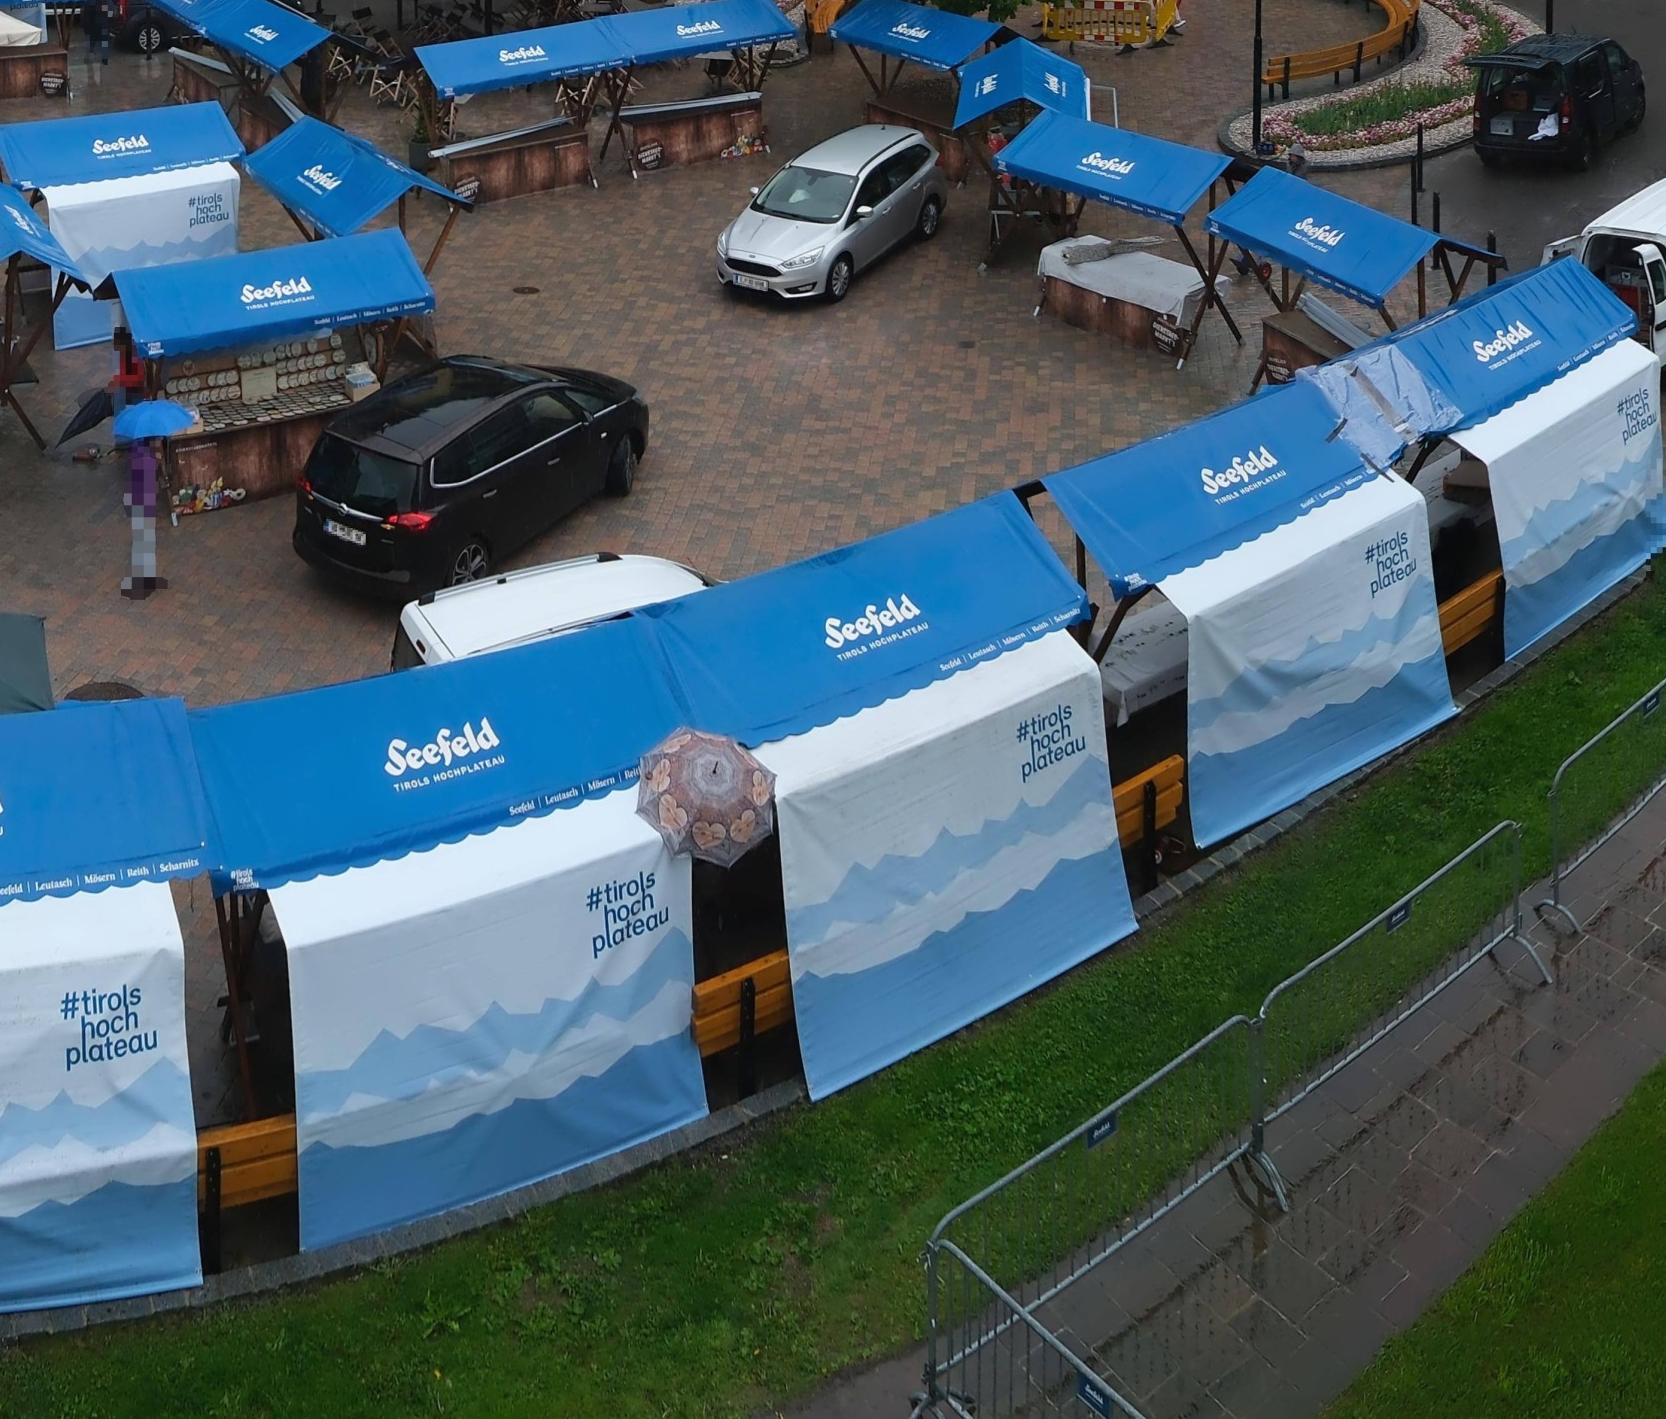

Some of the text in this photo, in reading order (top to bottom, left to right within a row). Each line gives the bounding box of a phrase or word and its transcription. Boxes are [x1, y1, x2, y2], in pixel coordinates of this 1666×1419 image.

[676, 20, 721, 37] Seefeld
[892, 23, 932, 40] Seefeld
[499, 45, 546, 63] Seefeld
[92, 134, 150, 155] Seefeld
[303, 164, 342, 191] Seefeld
[1081, 151, 1136, 176] Seefeld
[188, 192, 223, 209] #tirols
[195, 202, 222, 216] hoch
[189, 211, 230, 228] plateau
[1295, 217, 1345, 247] Seefeld
[240, 276, 312, 304] Seefeld
[245, 295, 315, 311] TIROLS HOCHPLATEAU
[1472, 320, 1533, 363] Seefeld
[1617, 388, 1649, 415] #tirols
[1625, 401, 1649, 425] hoch
[1200, 445, 1278, 495] Seefeld
[1215, 469, 1287, 506] TIROLS HOCHPLATEAU
[1365, 531, 1409, 565] #tirols
[1376, 547, 1409, 574] hoch
[1371, 557, 1417, 598] plateau
[824, 593, 921, 649] Seefeld
[837, 622, 929, 662] TIROLS HOCHPLATEAU
[968, 643, 997, 660] Leutasch
[1017, 704, 1072, 743] #tirols
[1031, 721, 1071, 754] hoch
[384, 717, 500, 777] Seefeld
[1021, 736, 1086, 783] plateau
[393, 755, 506, 793] TIROLS HOCHPLATEAU
[509, 801, 536, 816] Seefeld
[545, 788, 579, 806] Leutasch
[588, 776, 616, 792] Mösern
[35, 877, 73, 893] Leutasch
[84, 871, 116, 885] Mösern
[127, 865, 149, 878] Reith
[159, 858, 200, 873] Scharnitz
[587, 871, 656, 912] #tirols
[603, 891, 655, 926] hoch
[592, 906, 670, 959] plateau
[60, 984, 142, 1020] #tirols
[80, 1005, 140, 1041] hoch
[66, 1027, 158, 1072] plateau
